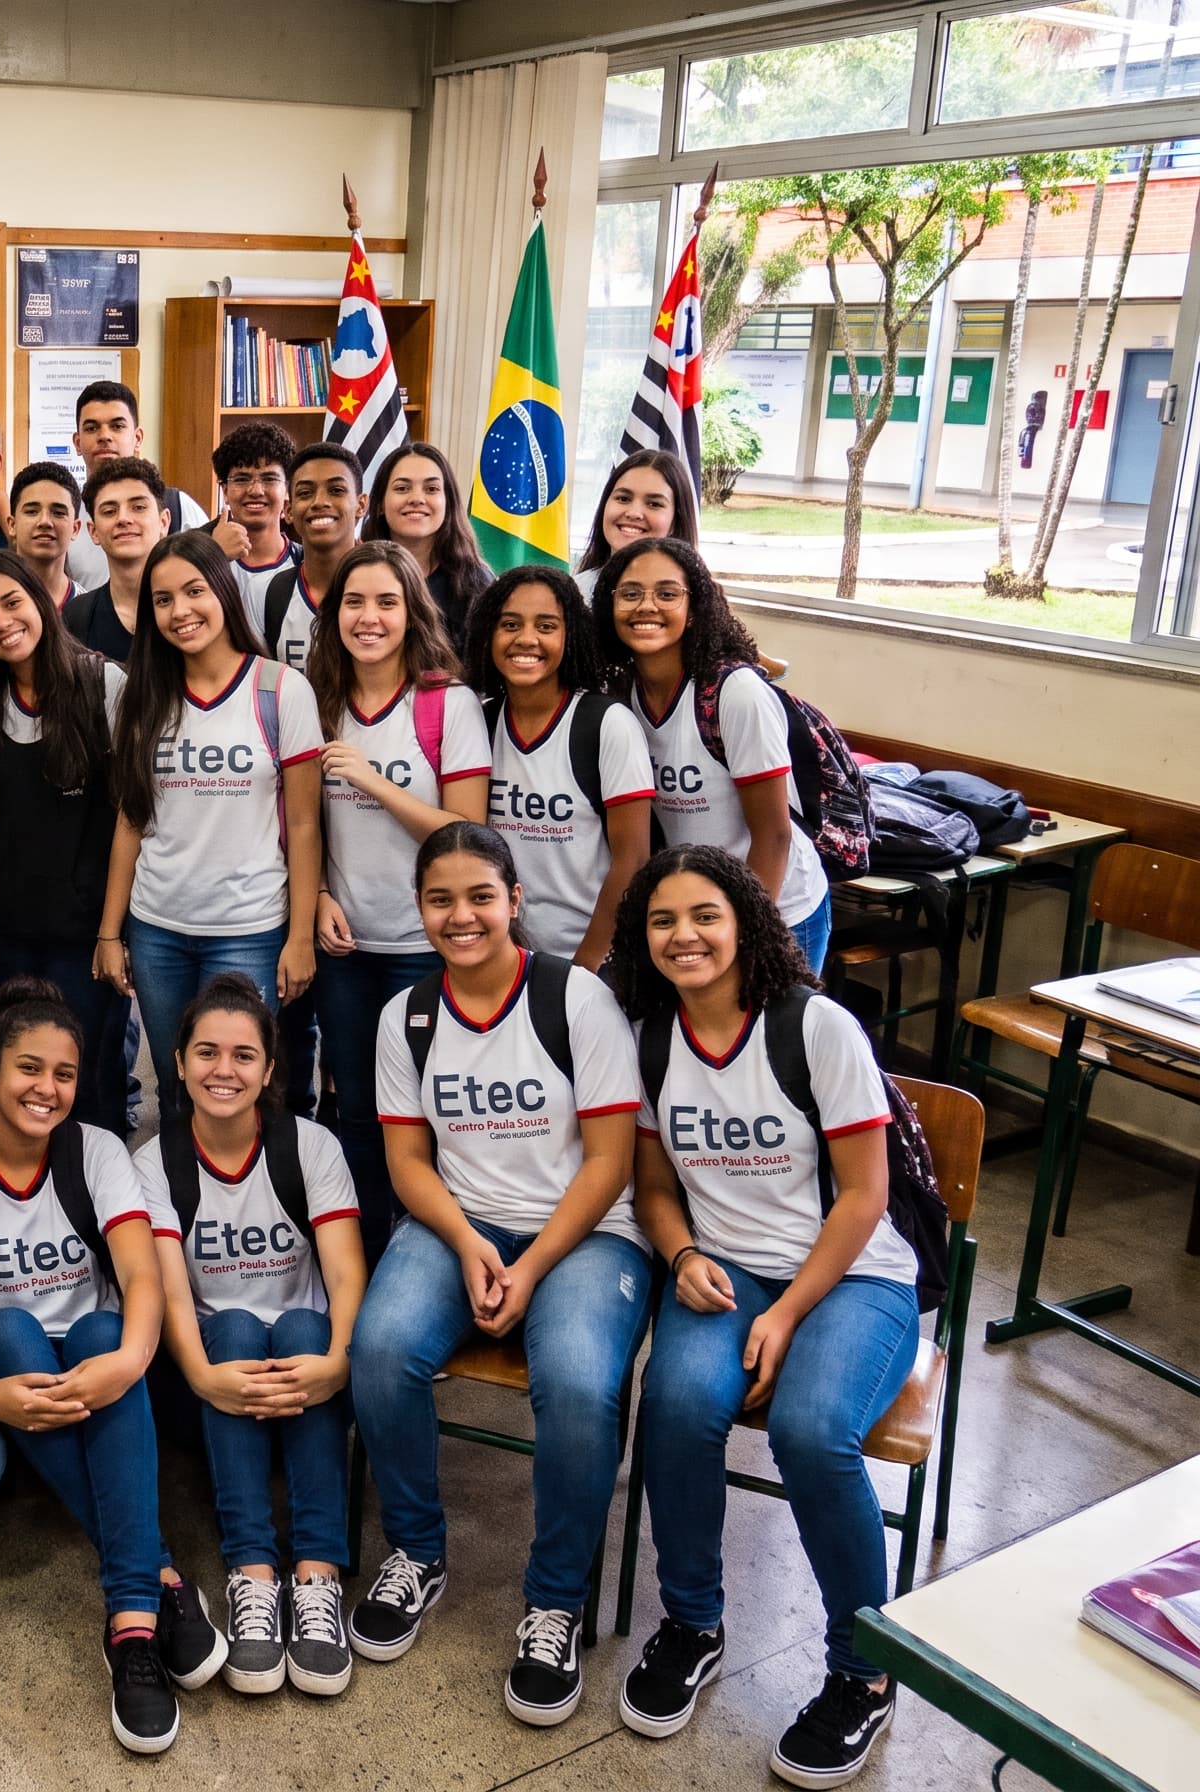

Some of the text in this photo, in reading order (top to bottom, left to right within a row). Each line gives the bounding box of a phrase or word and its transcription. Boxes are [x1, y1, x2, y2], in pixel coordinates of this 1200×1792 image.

[152, 736, 254, 774] Etec
[650, 756, 703, 794] tec
[488, 778, 574, 822] Etec
[433, 1073, 546, 1118] Etec
[448, 1117, 549, 1132] Centro Paula Souza
[669, 1104, 786, 1152] Etec
[682, 1157, 720, 1168] Centro
[720, 1156, 752, 1167] Paula
[194, 1220, 295, 1260] Etec
[202, 1264, 236, 1274] Centro
